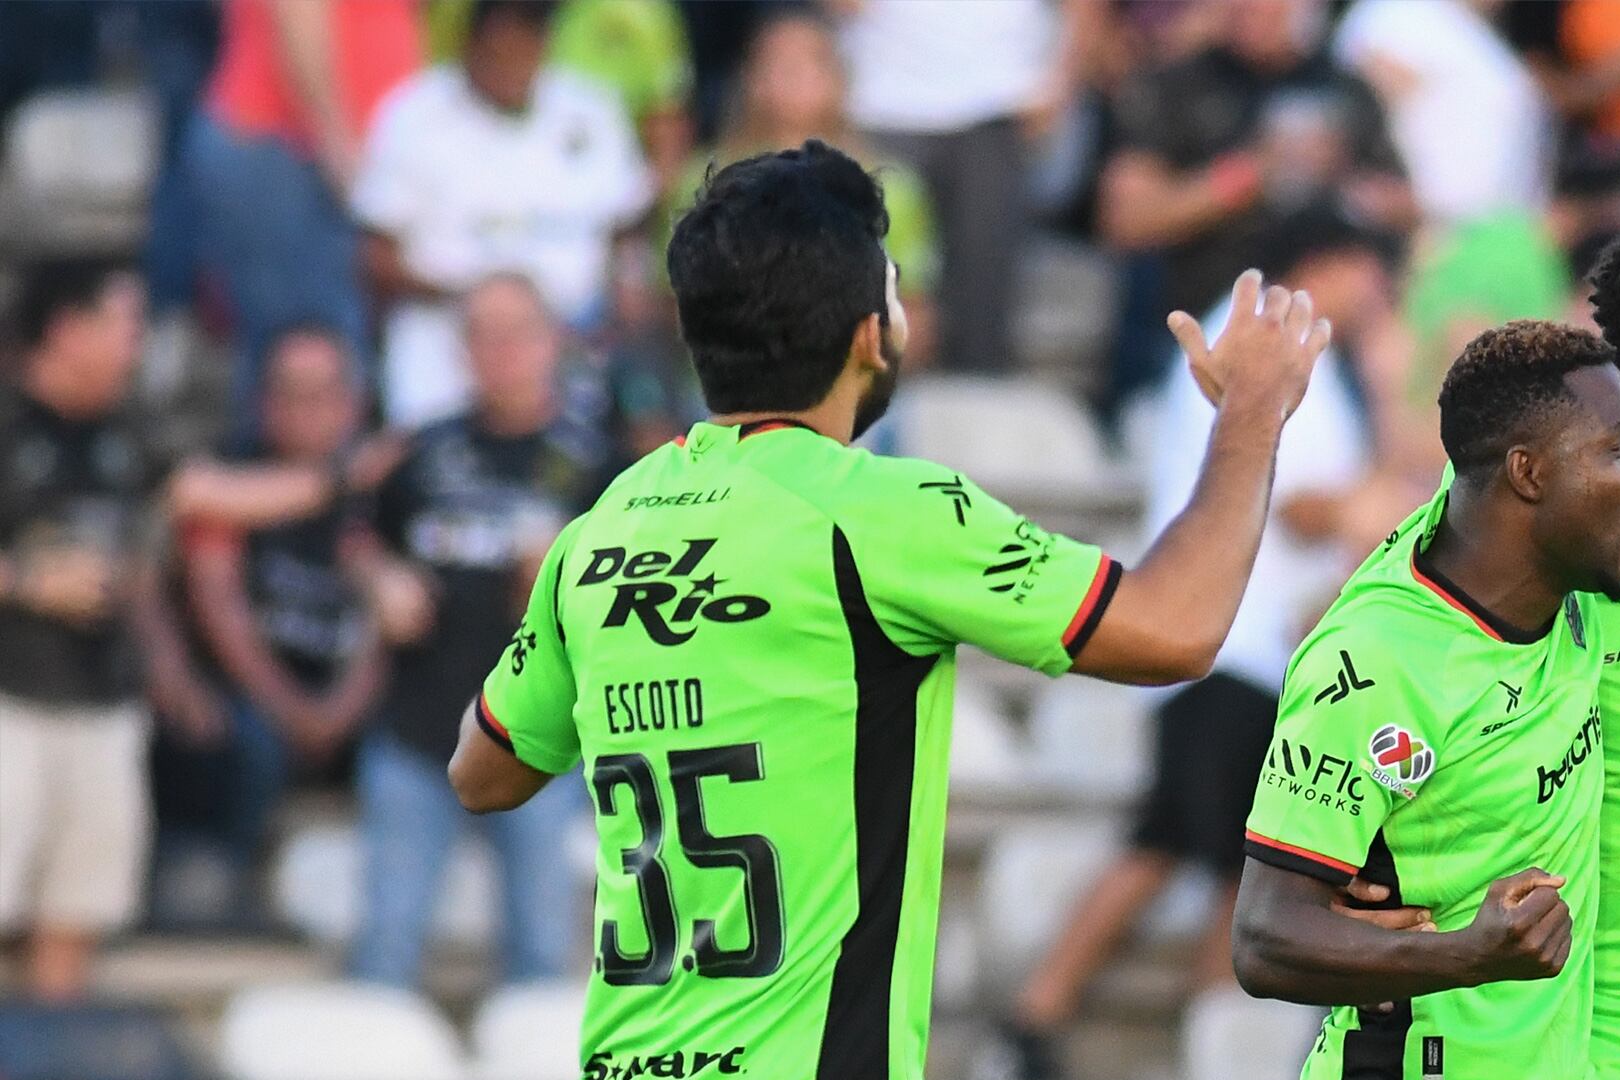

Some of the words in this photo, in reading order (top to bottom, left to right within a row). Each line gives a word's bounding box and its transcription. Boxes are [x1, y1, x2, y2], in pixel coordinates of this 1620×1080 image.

[576, 538, 719, 587] Del
[605, 678, 704, 734] ESCOTO
[1263, 772, 1361, 816] ETWORKS
[592, 742, 786, 986] 35
